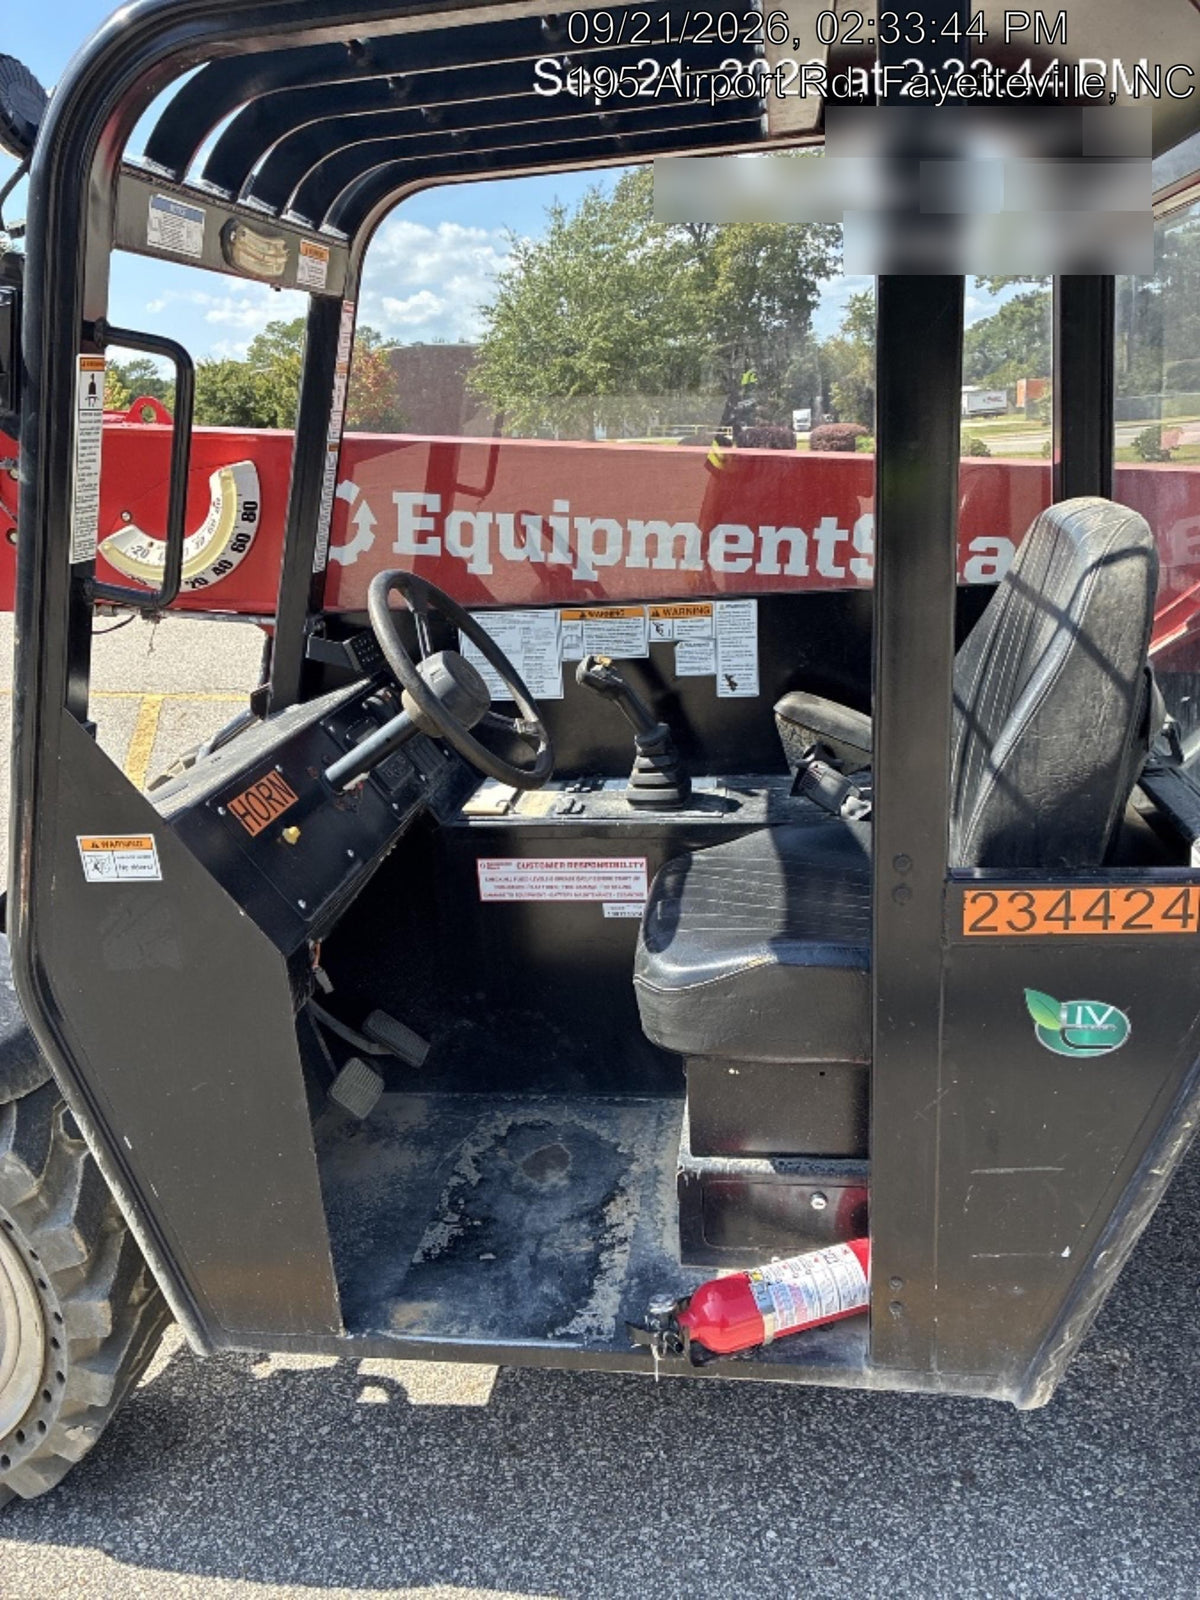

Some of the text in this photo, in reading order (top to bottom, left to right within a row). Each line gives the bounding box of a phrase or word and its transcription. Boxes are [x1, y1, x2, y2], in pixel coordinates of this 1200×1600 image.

[241, 500, 258, 523] 80
[230, 533, 251, 553] 60
[211, 559, 234, 577] 40
[662, 606, 711, 617] WARNING
[230, 773, 296, 833] HORN
[968, 888, 1195, 932] 234424
